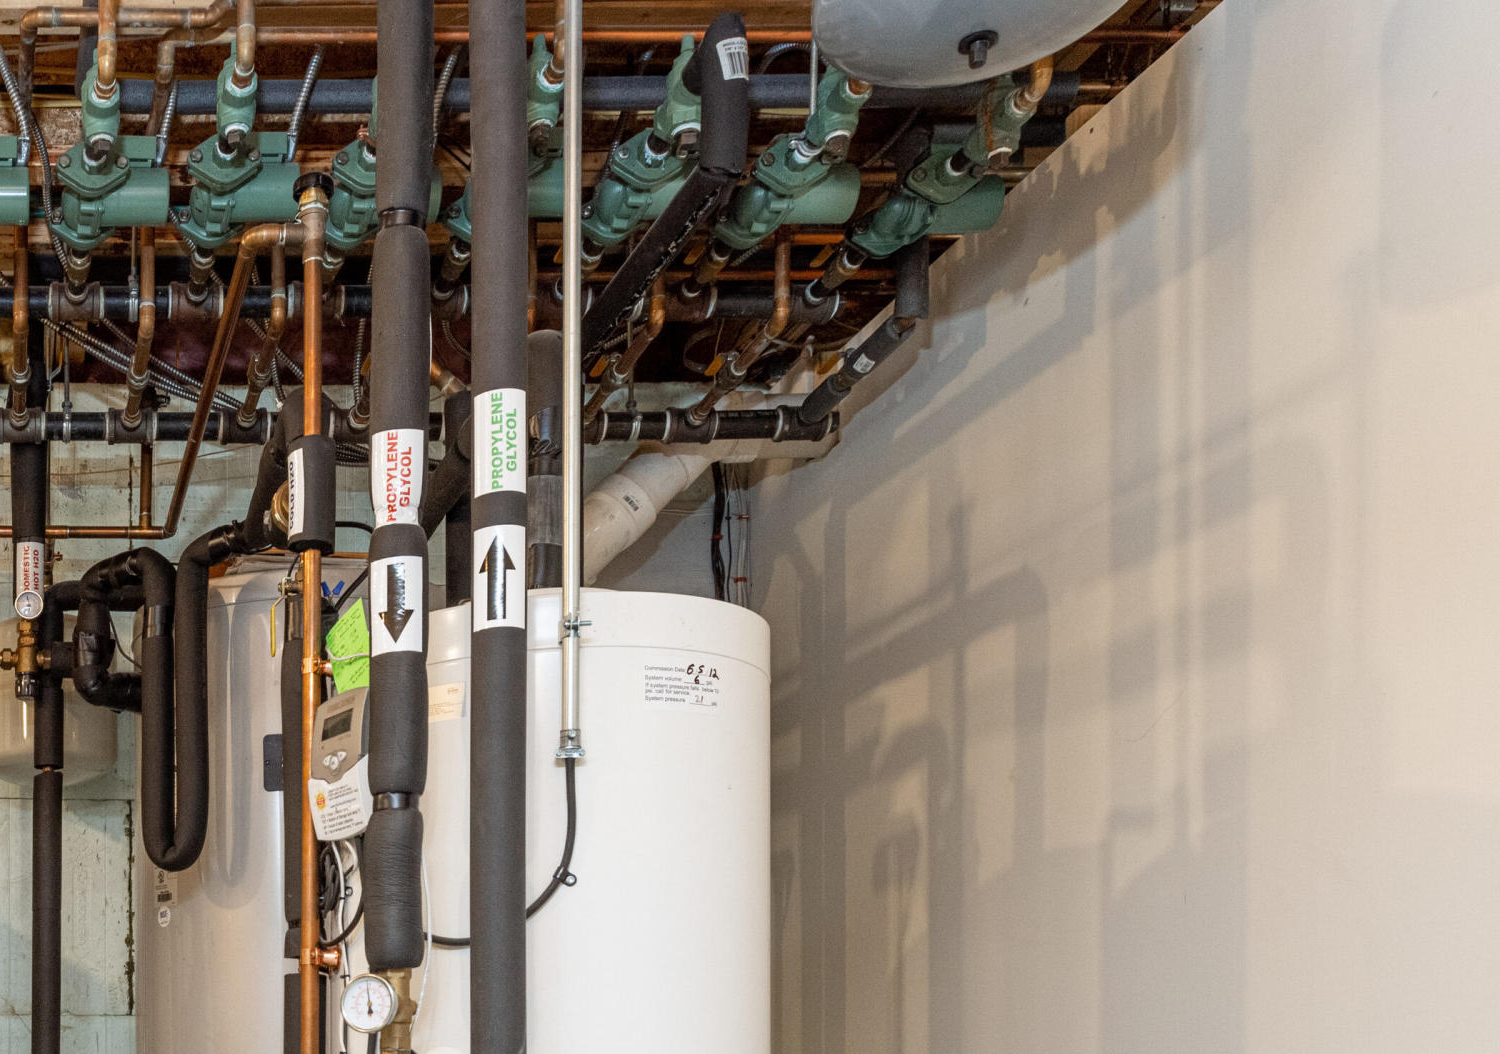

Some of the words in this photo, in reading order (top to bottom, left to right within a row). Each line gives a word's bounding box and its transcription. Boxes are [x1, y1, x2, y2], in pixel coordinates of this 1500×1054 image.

[491, 392, 503, 490] PROPYLENE
[506, 408, 517, 472] GLYCOL
[386, 431, 398, 522] PROPYLENE
[400, 446, 412, 508] GLYCOL
[686, 664, 694, 675] 6
[698, 665, 704, 674] 5
[709, 668, 719, 680] 12
[694, 676, 700, 684] 6
